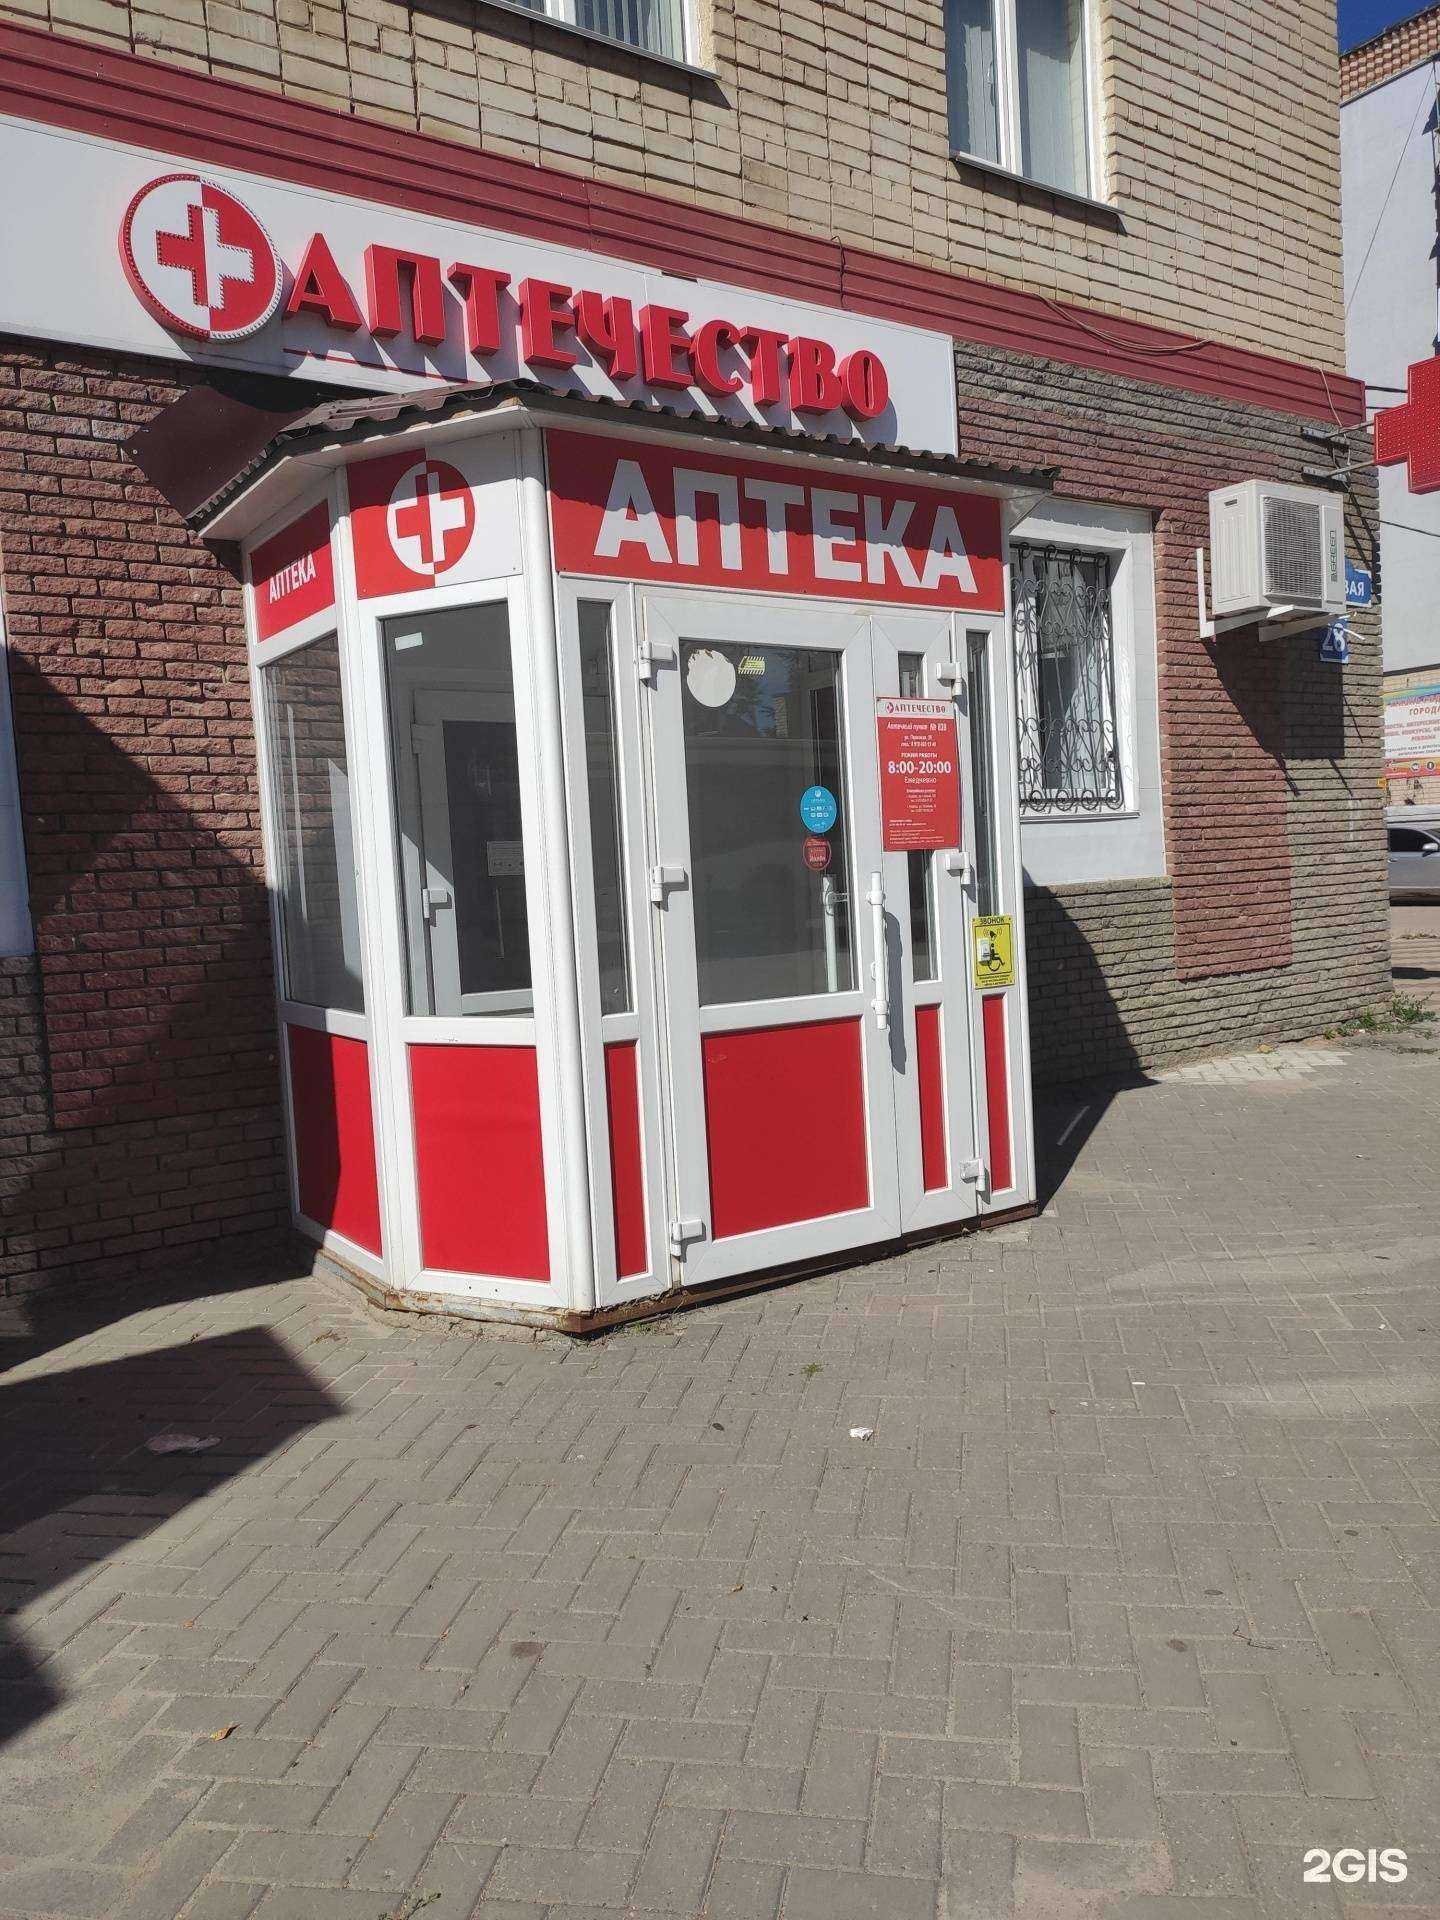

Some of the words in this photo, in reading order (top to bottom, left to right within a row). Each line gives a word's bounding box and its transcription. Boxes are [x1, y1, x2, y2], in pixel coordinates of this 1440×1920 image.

[286, 233, 889, 422] АПТЕЧЕСТВО
[594, 458, 978, 593] АПТЕКА
[269, 551, 316, 604] АПТЕКА
[894, 703, 946, 713] АПТЕЧЕСТВО
[1409, 706, 1440, 716] ГОРОД
[888, 760, 951, 774] 8:00-20:00
